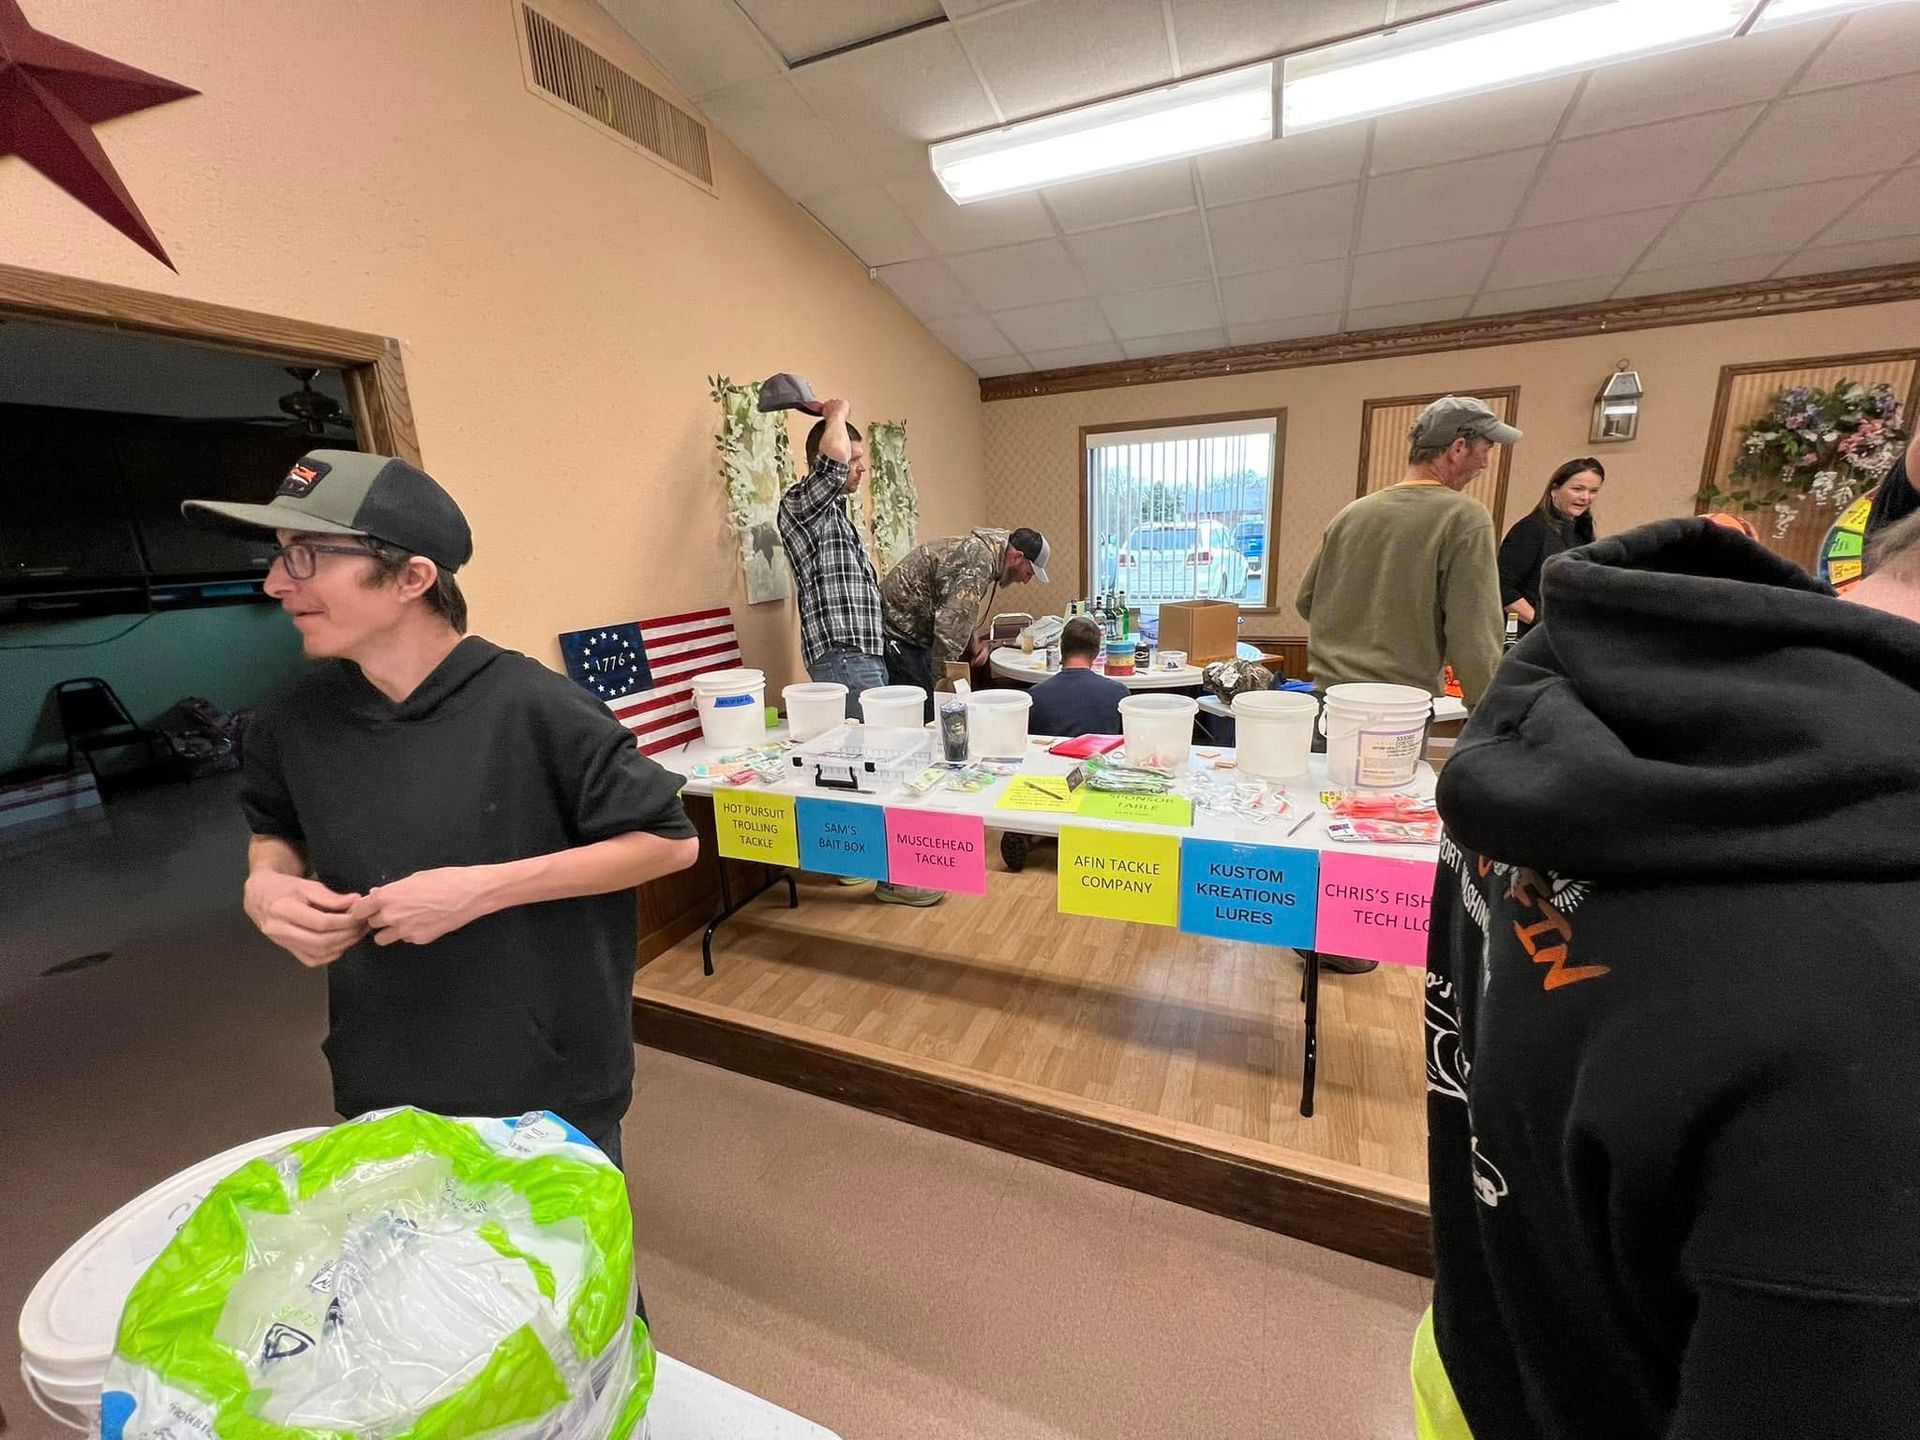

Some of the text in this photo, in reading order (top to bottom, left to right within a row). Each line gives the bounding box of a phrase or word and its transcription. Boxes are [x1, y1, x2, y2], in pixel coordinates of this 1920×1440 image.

[595, 652, 625, 672] 1776
[1110, 793, 1174, 803] SPONSOR
[1118, 801, 1159, 811] TABLE
[723, 803, 785, 819] HOT PURSUIT
[732, 819, 778, 834] TROLLING
[824, 822, 857, 836] SAM'S
[739, 835, 774, 848] TACKLE
[819, 838, 866, 853] BAIT BOX
[896, 833, 974, 853] MUSCLEHEAD
[915, 852, 956, 868] TACKLE
[1074, 854, 1161, 876] AFIN TACKLE
[1210, 863, 1284, 884] KUSTOM
[1081, 875, 1153, 894] COMPANY
[1197, 882, 1297, 907] KREATIONS
[1215, 905, 1274, 926] LURES
[1353, 909, 1398, 929] TECH
